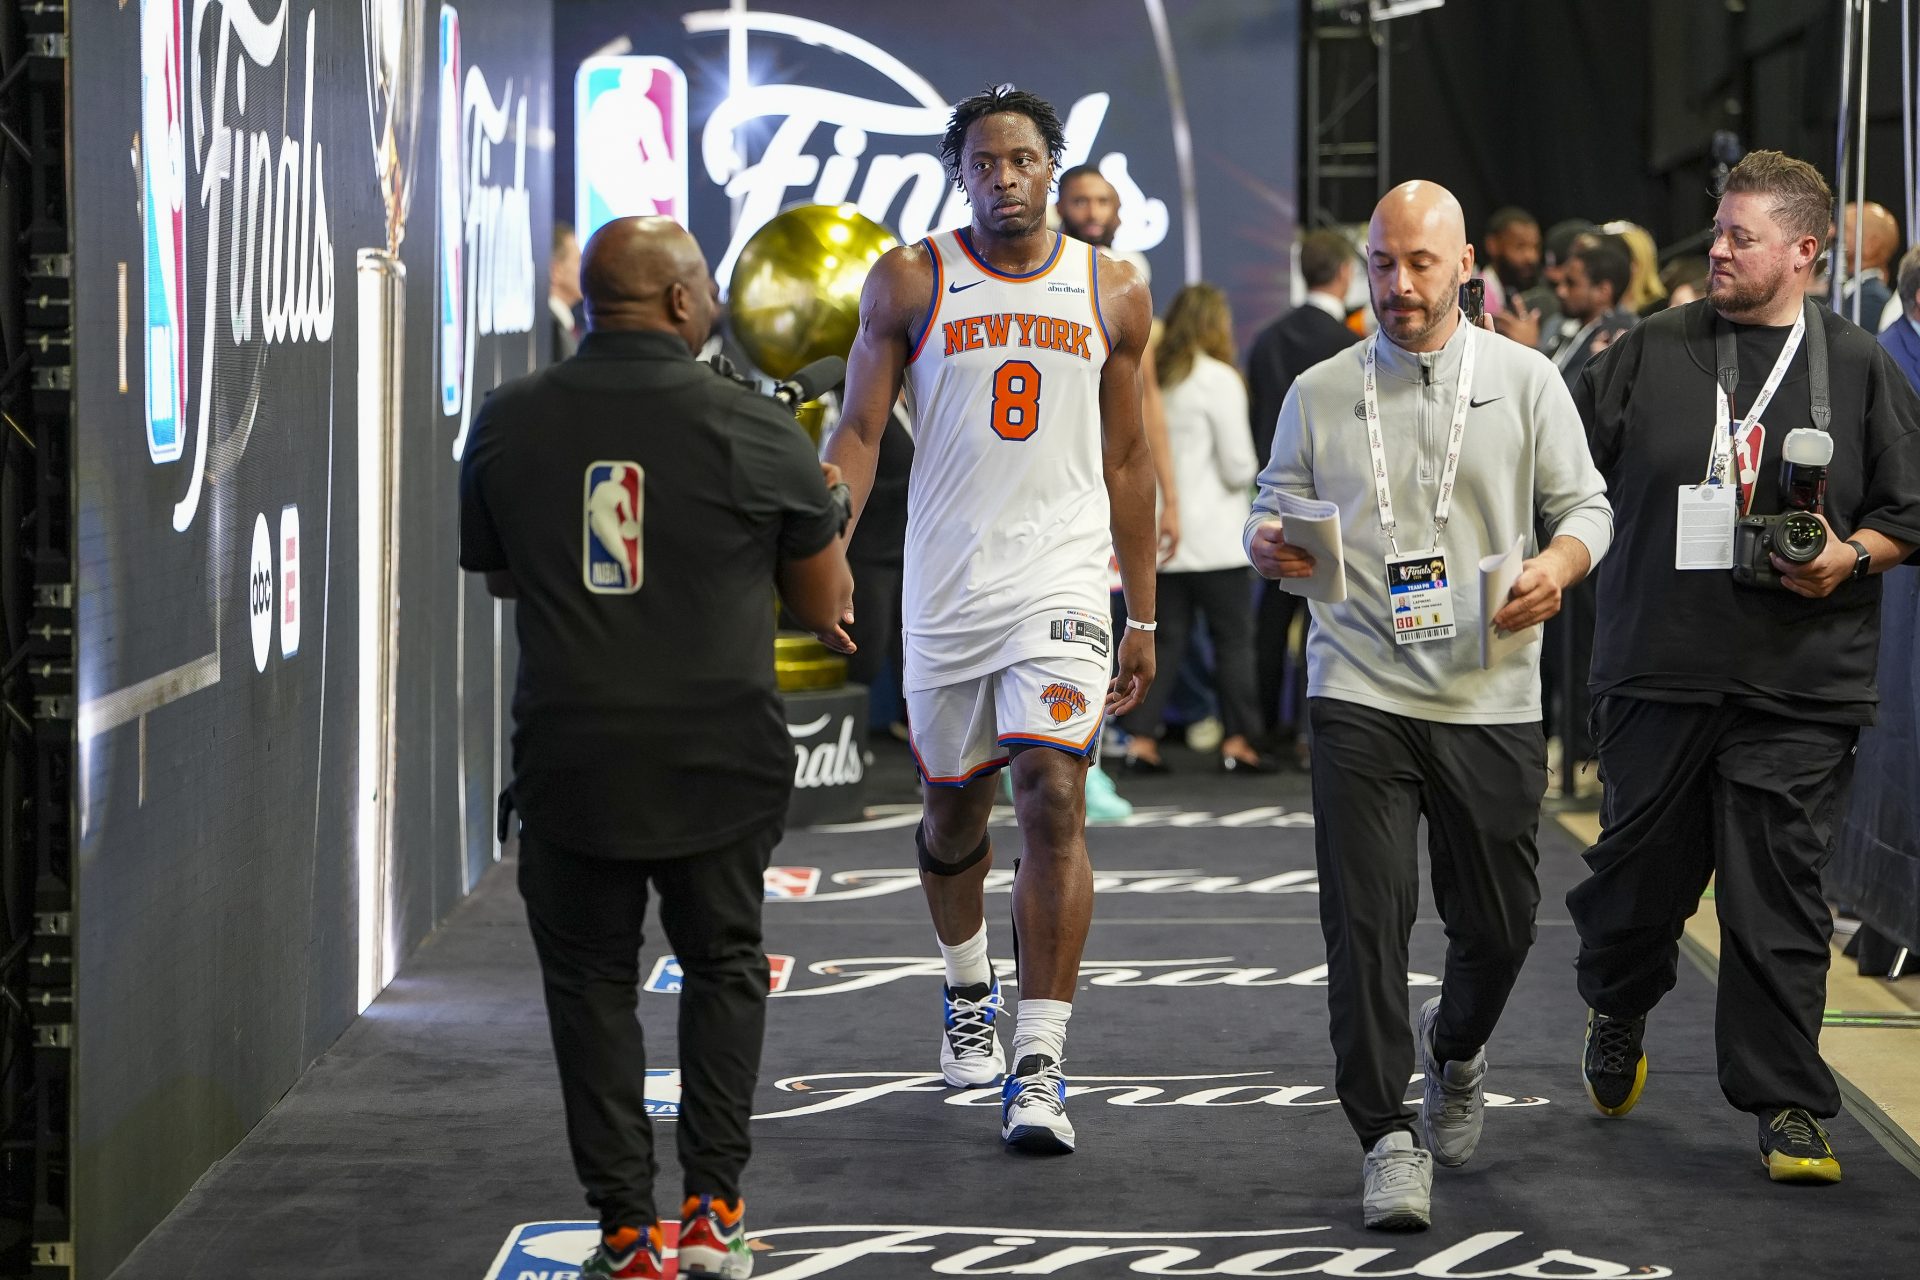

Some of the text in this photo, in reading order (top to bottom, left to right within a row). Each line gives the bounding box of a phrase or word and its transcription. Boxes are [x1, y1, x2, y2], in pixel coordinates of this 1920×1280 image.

[702, 84, 1169, 303] Finls
[173, 0, 334, 532] Finals
[1063, 286, 1085, 294] dhabi
[942, 313, 1092, 362] NEW YORK
[990, 359, 1042, 441] 8
[252, 561, 271, 616] abc
[1405, 564, 1431, 580] Finals
[1040, 683, 1086, 714] KNICKS
